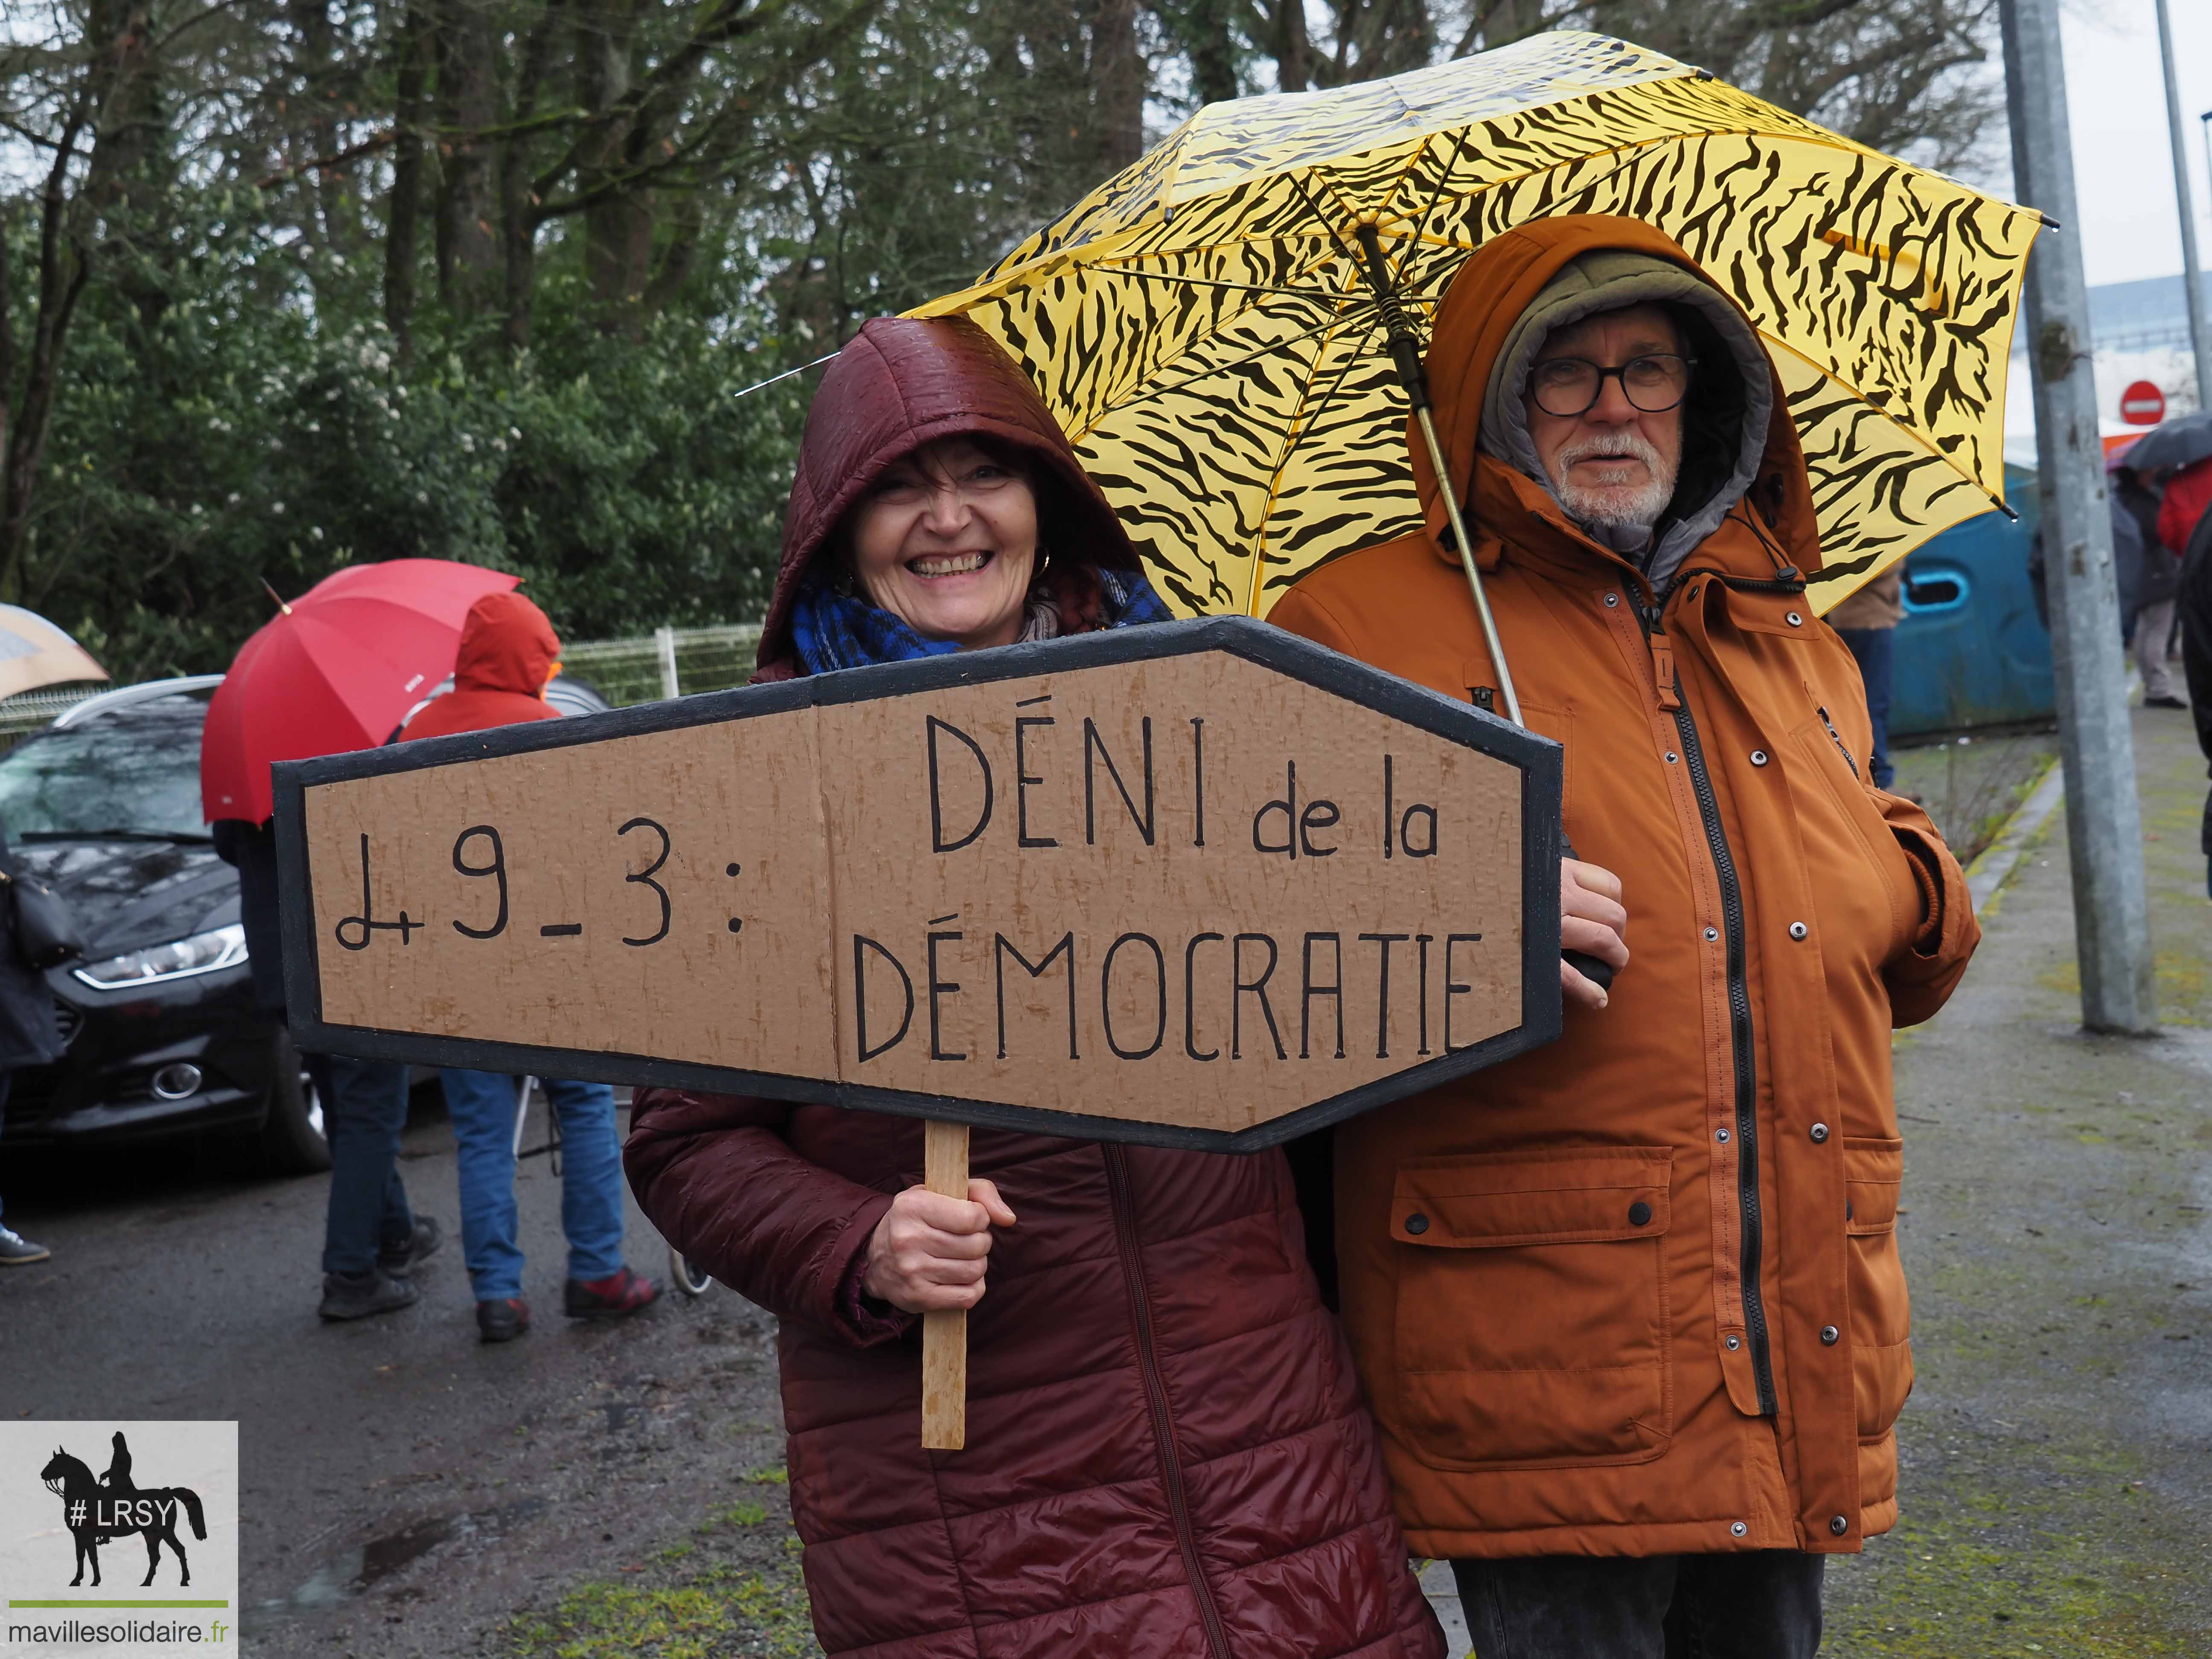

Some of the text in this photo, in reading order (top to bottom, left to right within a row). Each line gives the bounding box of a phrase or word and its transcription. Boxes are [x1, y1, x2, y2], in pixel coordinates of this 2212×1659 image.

[926, 695, 1438, 861] DÉNI de la
[853, 913, 1482, 1063] DÉMOCRATIE
